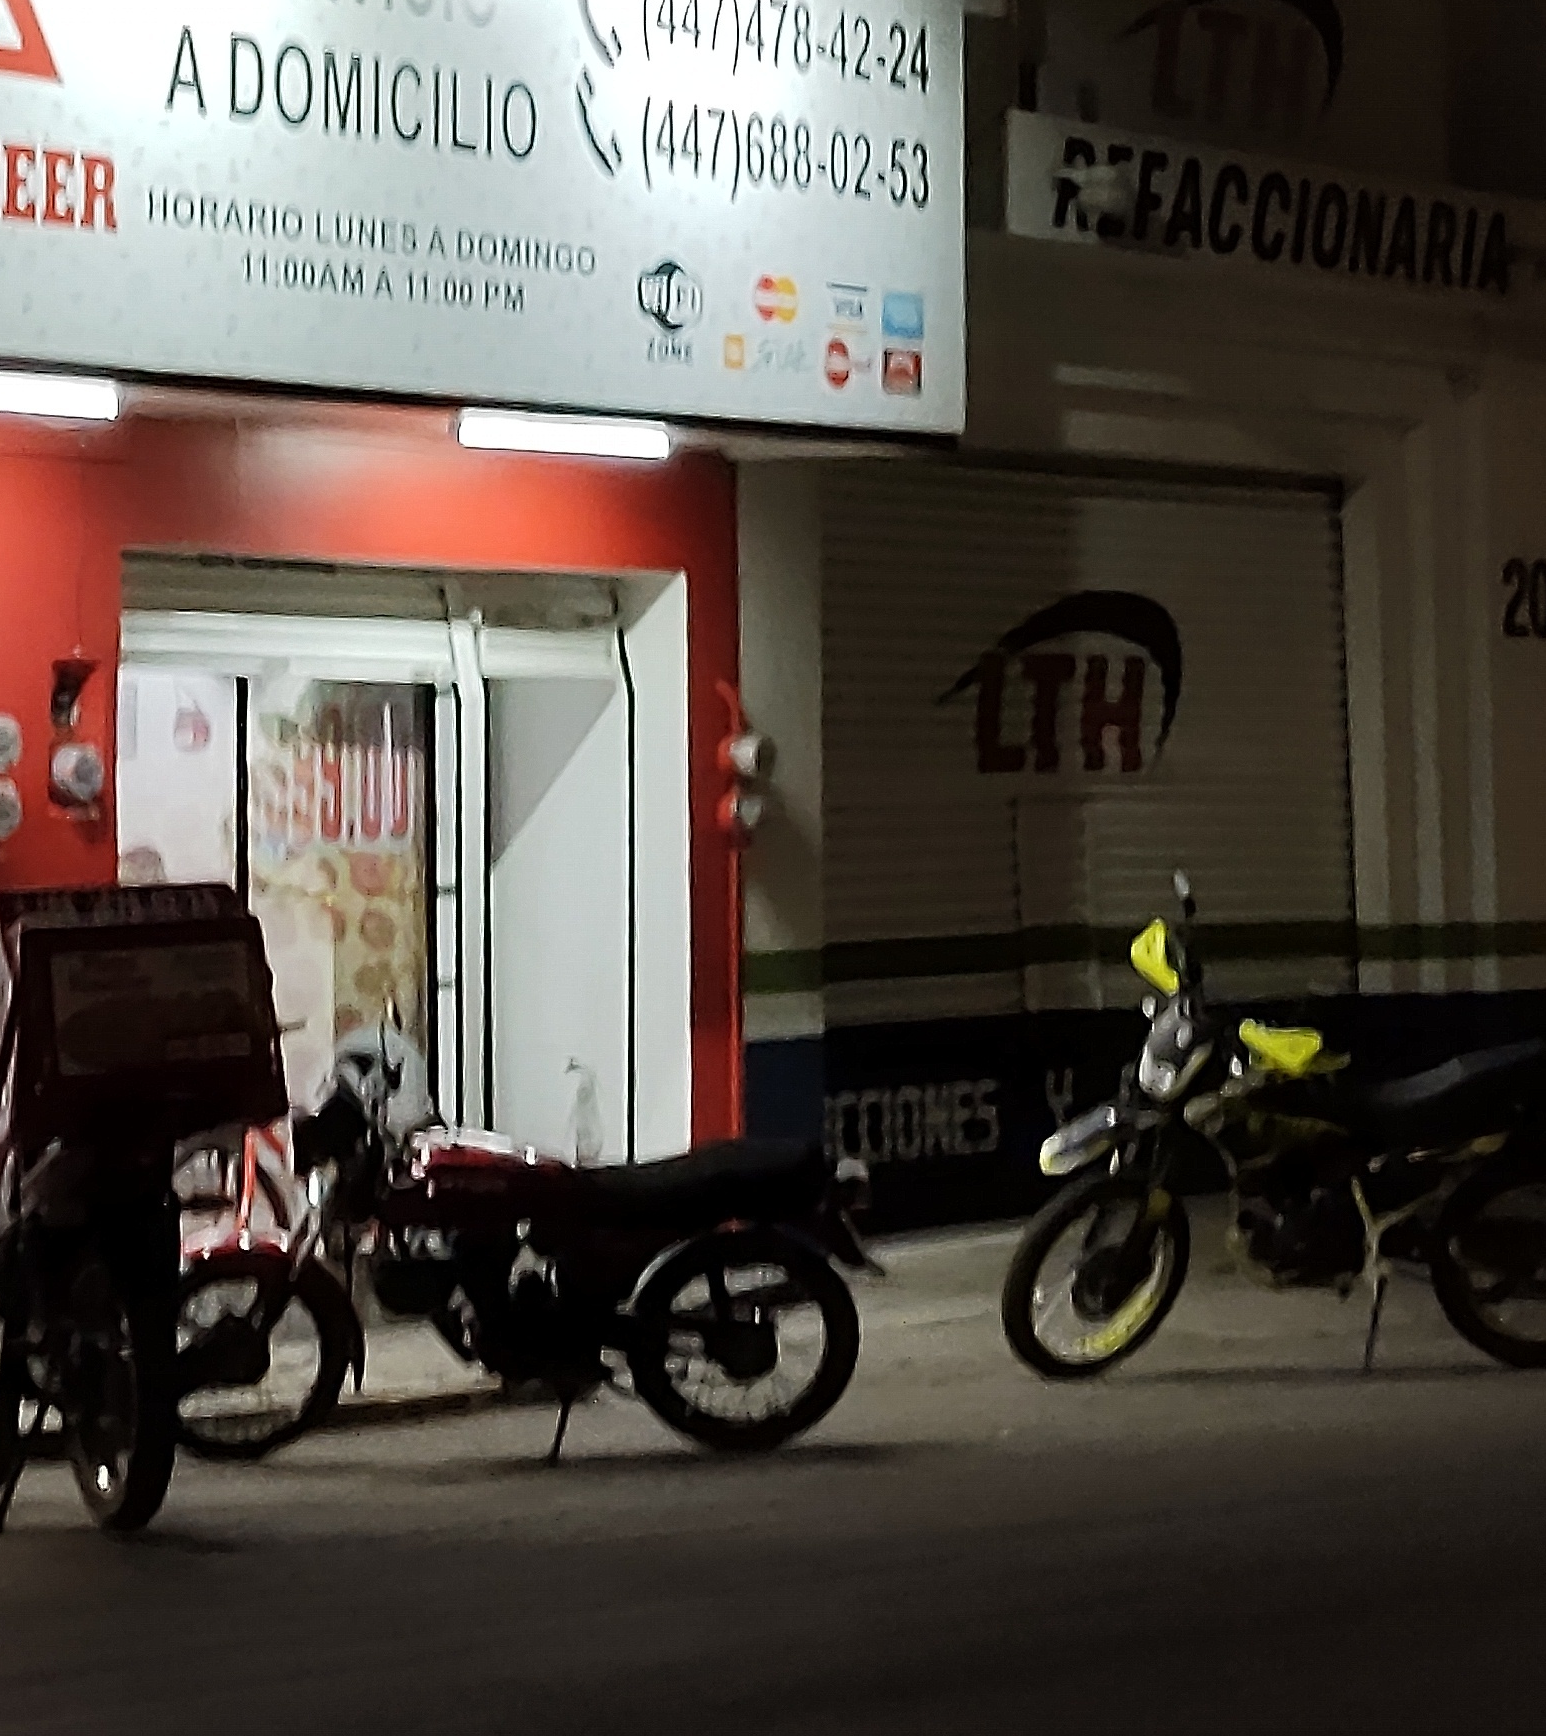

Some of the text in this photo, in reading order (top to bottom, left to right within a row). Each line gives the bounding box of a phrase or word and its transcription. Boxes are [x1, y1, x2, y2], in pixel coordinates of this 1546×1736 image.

[164, 24, 539, 160] A DOMICILIO
[1151, 0, 1314, 132] LTH
[642, 95, 930, 211] (447)688-02-53
[147, 186, 597, 277] HORARIO LUNES A DOMINGO
[374, 265, 394, 300] A
[974, 651, 1144, 774] LTH
